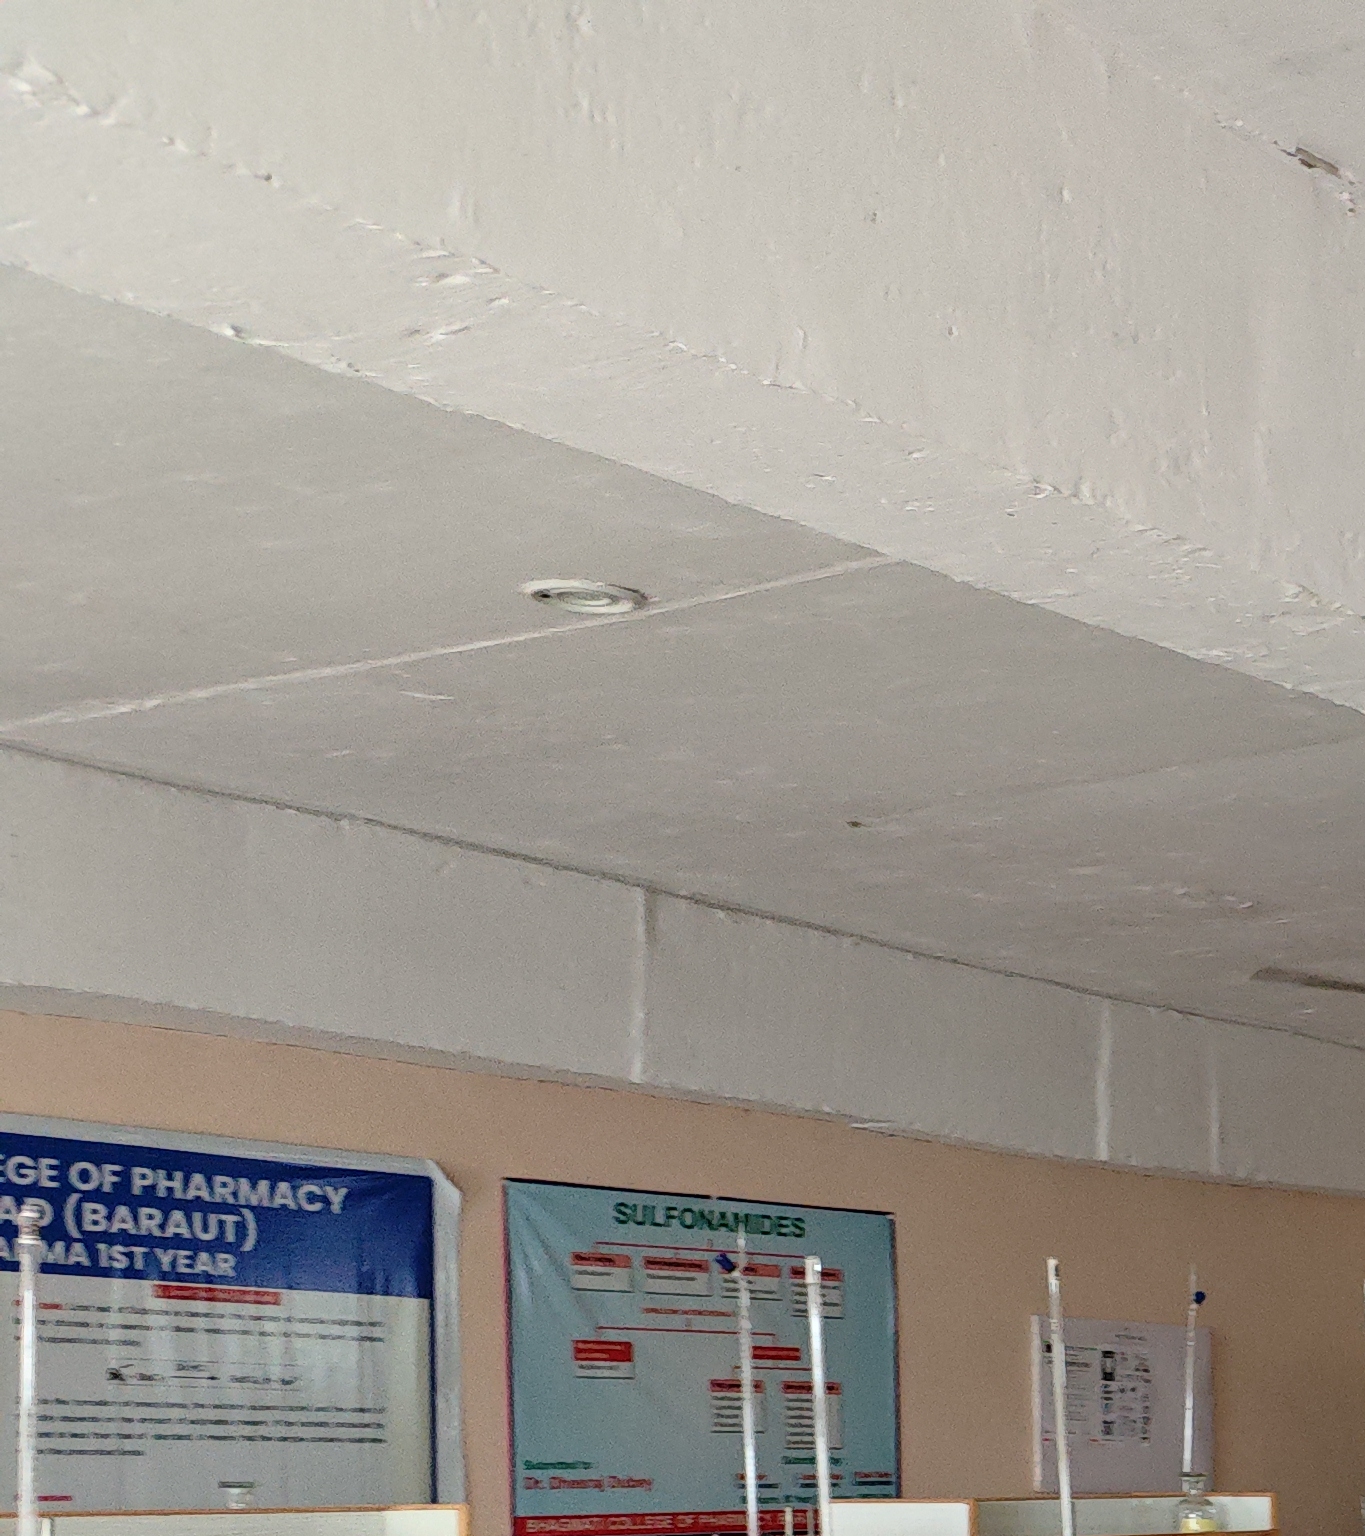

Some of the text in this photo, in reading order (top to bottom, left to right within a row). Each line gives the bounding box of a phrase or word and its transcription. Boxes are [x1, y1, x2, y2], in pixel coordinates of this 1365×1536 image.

[68, 1161, 124, 1193] OF
[131, 1166, 351, 1215] PHARMACY
[62, 1192, 258, 1252] (BARAUT)
[612, 1201, 807, 1238] SULFONAMIDES
[95, 1242, 149, 1271] 1ST
[151, 1247, 237, 1278] YEAR
